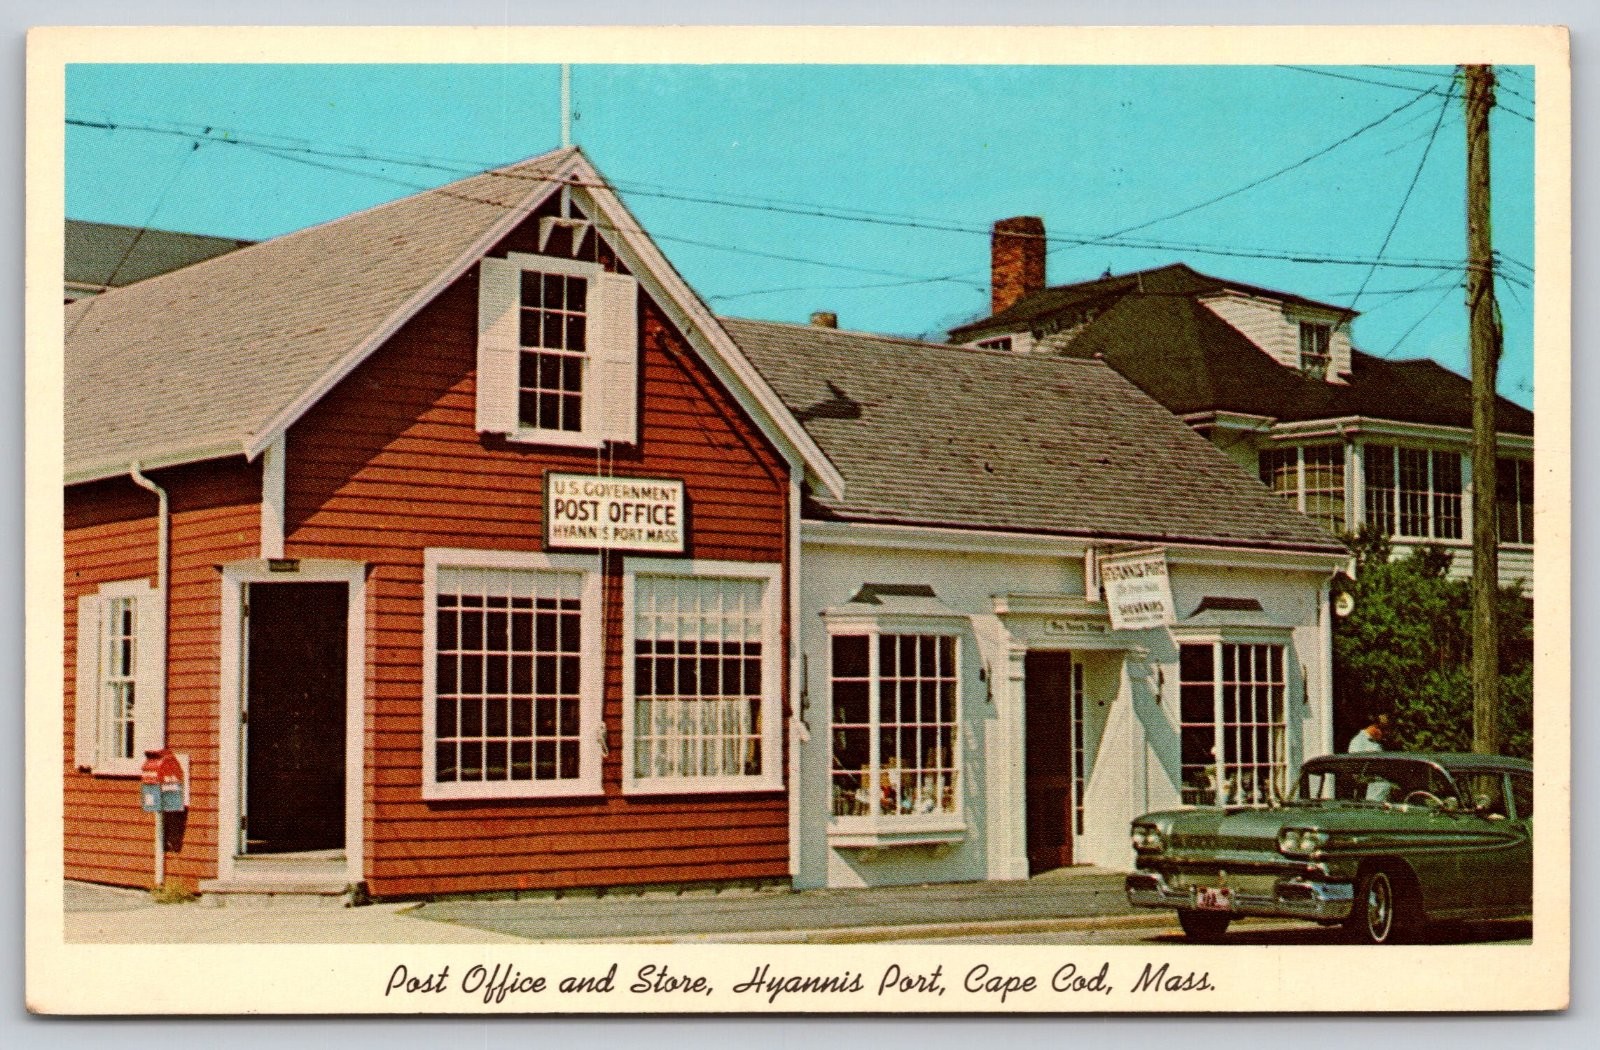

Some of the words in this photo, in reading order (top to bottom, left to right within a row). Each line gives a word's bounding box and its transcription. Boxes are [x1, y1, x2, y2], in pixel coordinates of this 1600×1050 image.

[584, 481, 677, 500] GOVERNMENT
[554, 499, 599, 521] POST
[609, 502, 676, 525] OFFICE
[553, 525, 609, 540] HYANNS
[613, 528, 643, 541] PORT
[386, 964, 449, 997] Post
[461, 963, 547, 1004] Office
[558, 963, 618, 994] and
[629, 964, 713, 997] Store,
[732, 964, 865, 1004] Hyannis
[877, 964, 946, 996] Port,
[963, 963, 1038, 1004] Cape
[1051, 962, 1113, 996] Cod,
[1130, 962, 1216, 993] Mass.
